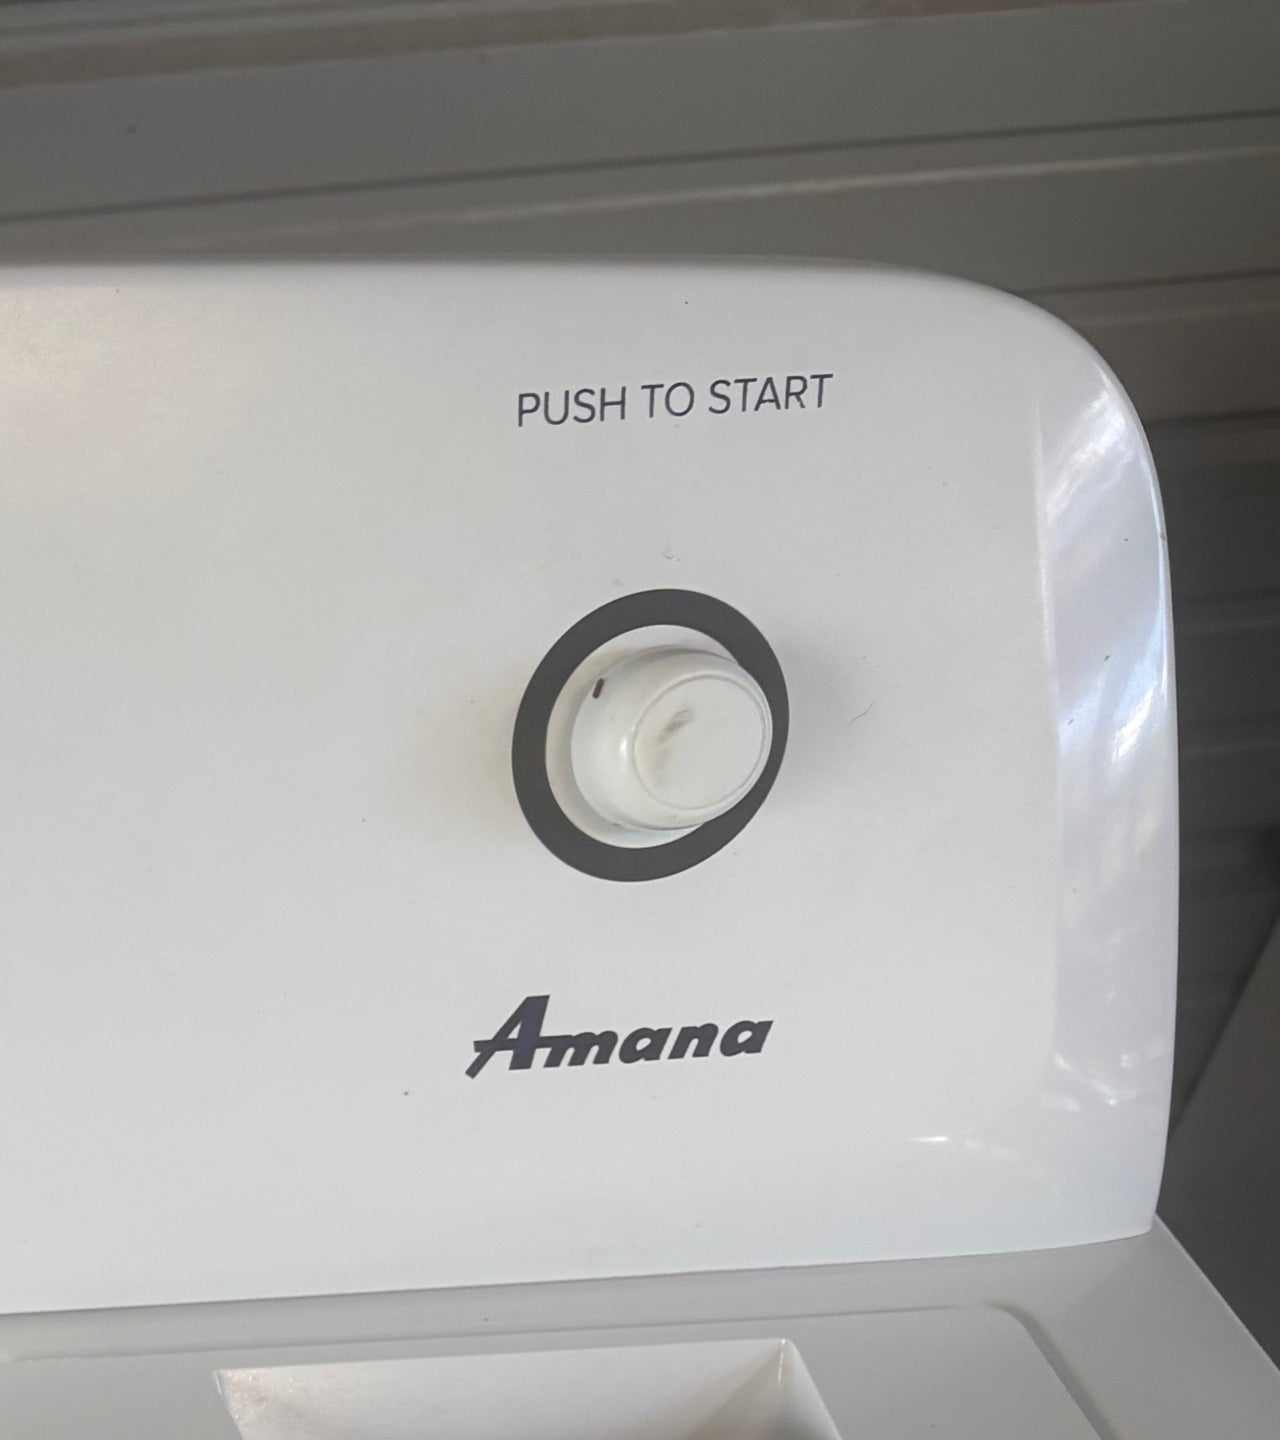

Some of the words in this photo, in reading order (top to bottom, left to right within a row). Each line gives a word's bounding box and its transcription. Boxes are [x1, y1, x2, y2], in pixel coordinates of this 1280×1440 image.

[516, 386, 627, 427] PUSH
[642, 382, 695, 420] TO
[709, 373, 834, 413] START
[464, 995, 774, 1080] Amana
